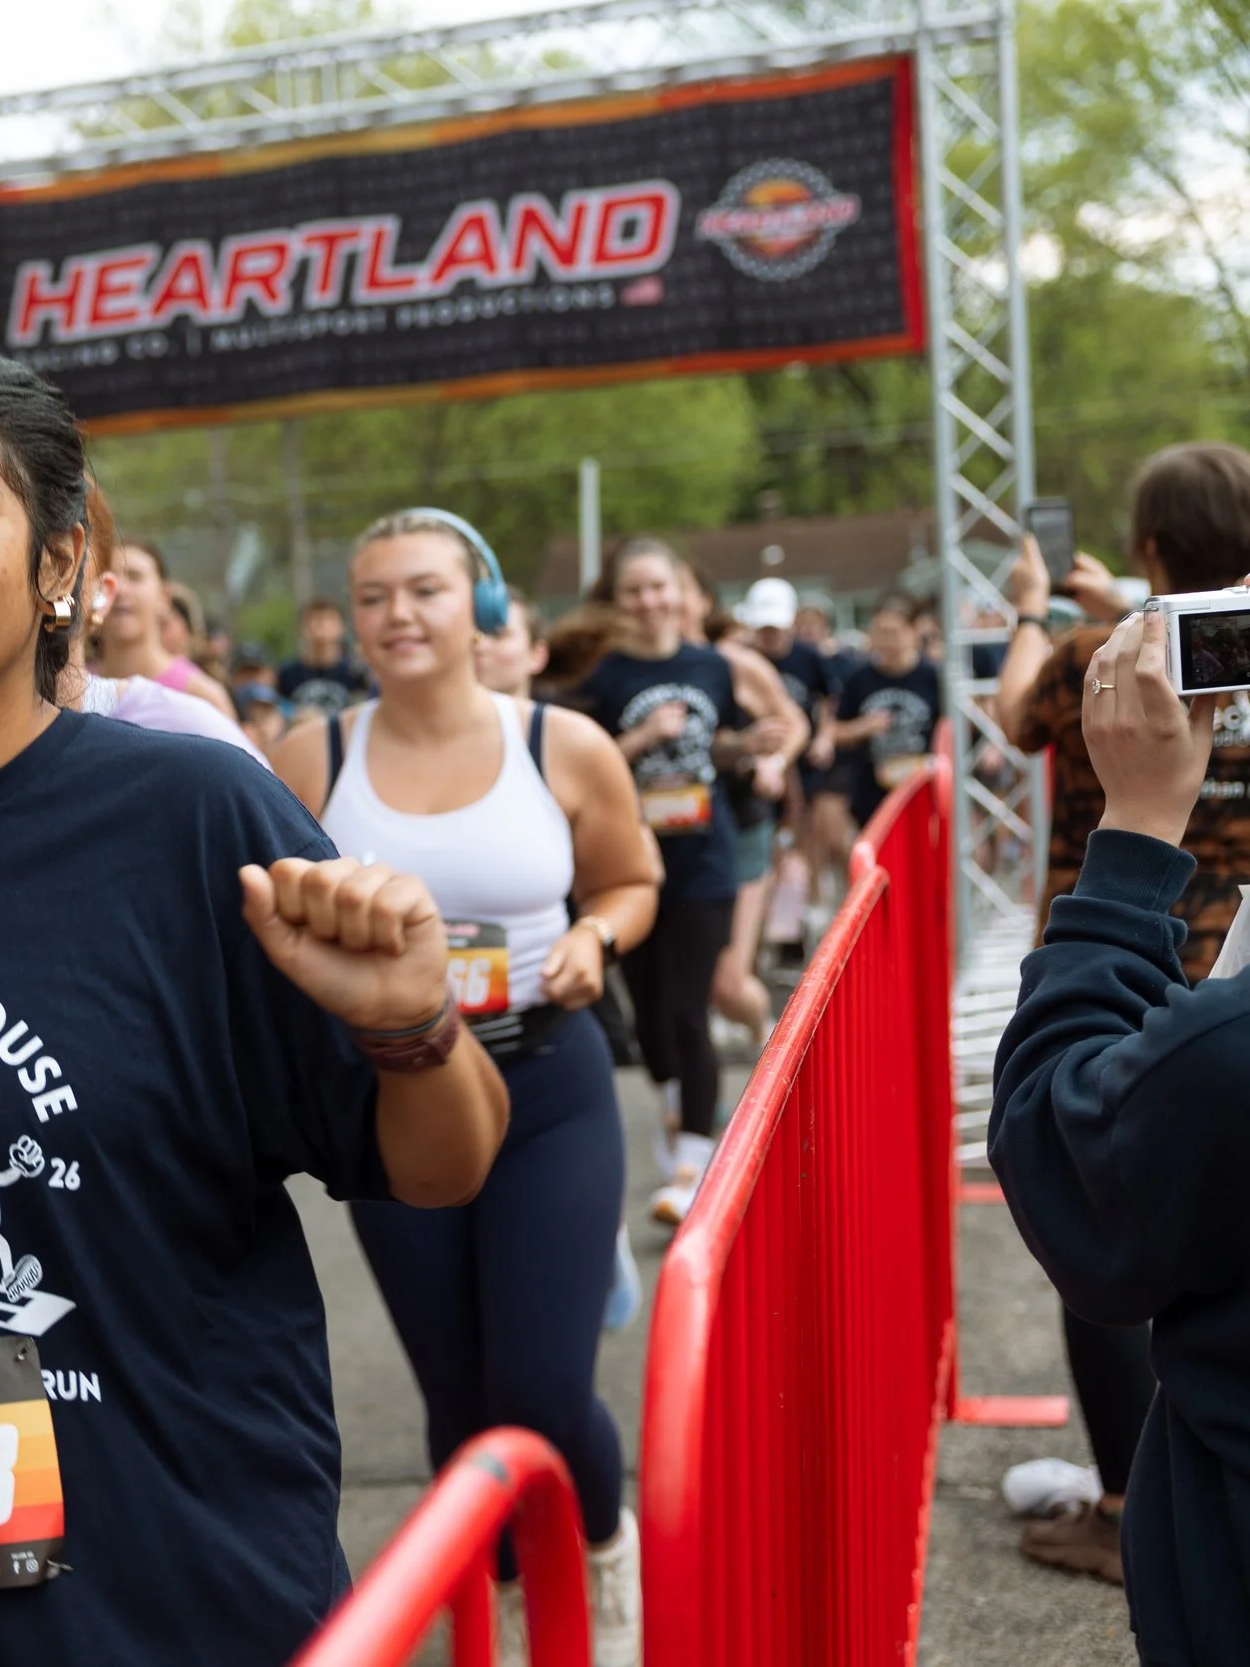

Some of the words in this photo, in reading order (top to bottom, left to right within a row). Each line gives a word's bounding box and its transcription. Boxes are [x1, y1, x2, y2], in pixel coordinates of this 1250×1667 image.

[6, 178, 681, 347] HEARTLAND
[395, 282, 617, 331] PRODUCTIONS
[48, 1157, 81, 1190] 26
[41, 1368, 102, 1402] RUN
